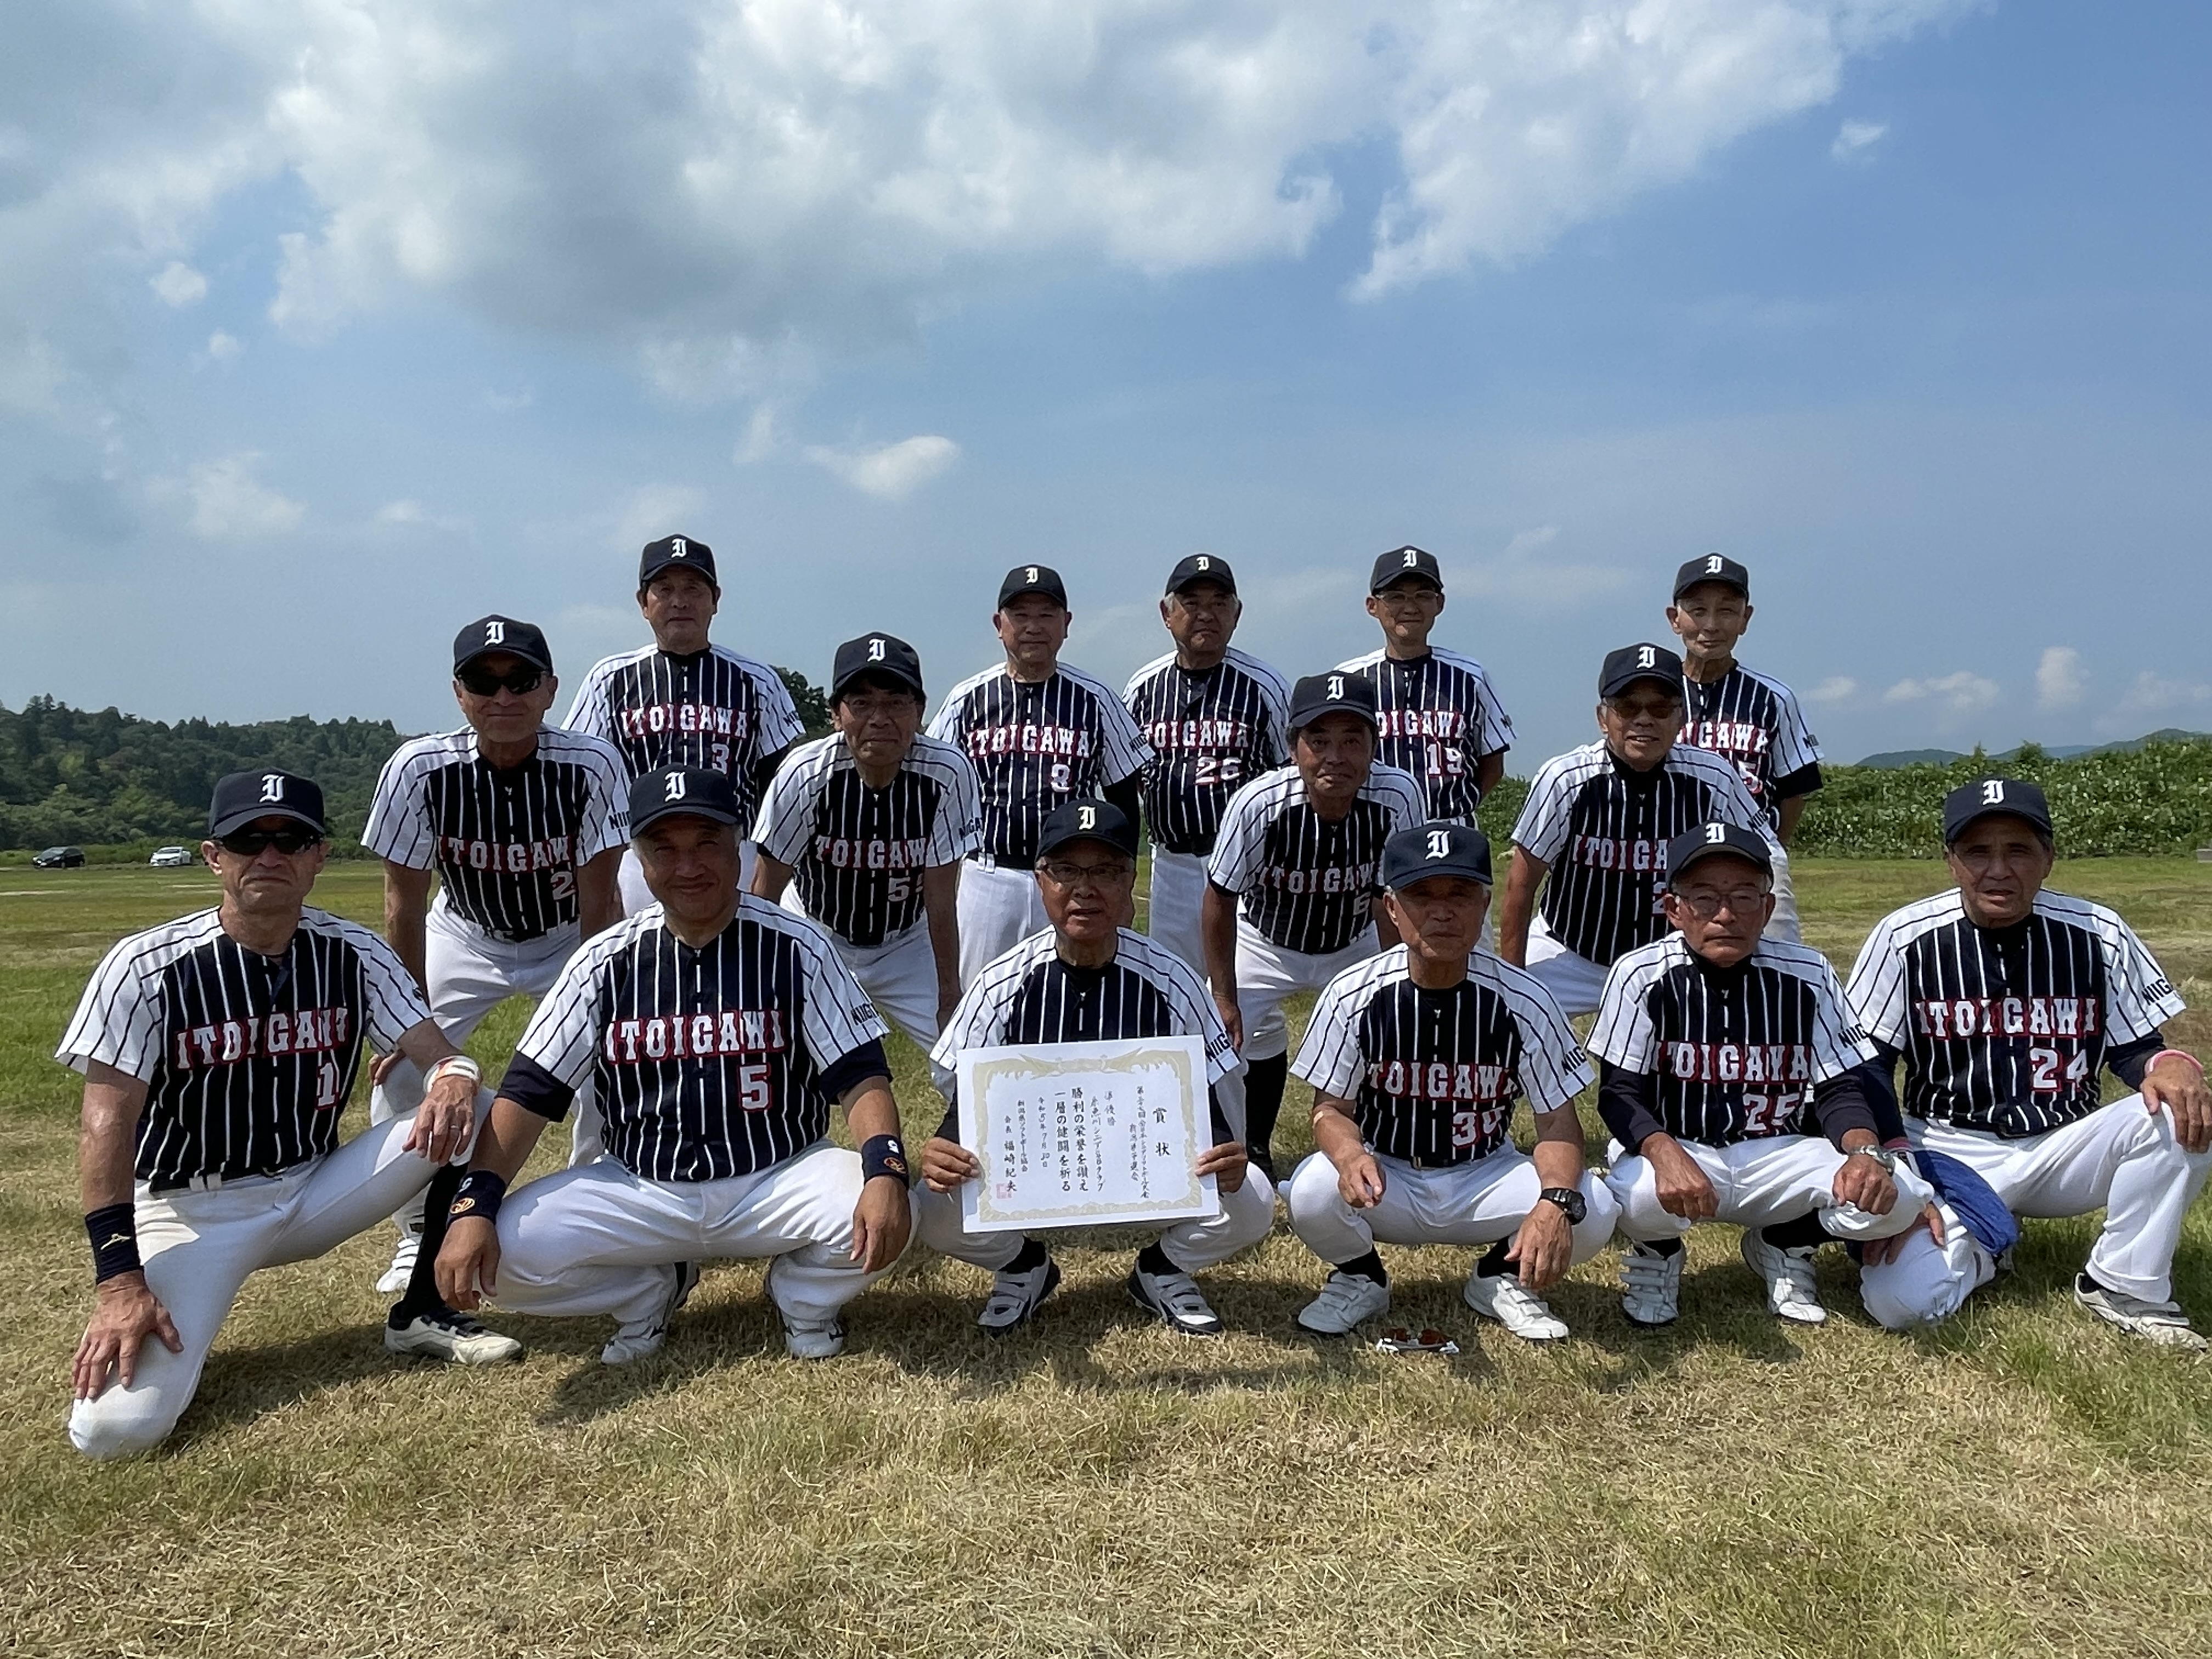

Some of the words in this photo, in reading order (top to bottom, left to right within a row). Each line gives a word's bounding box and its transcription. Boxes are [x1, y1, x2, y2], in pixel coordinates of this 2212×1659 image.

[1427, 744, 1462, 775] 19
[550, 871, 576, 901] 2
[318, 1062, 336, 1107] 1
[740, 1064, 769, 1109] 5
[2032, 1048, 2089, 1089] 24
[1152, 1107, 1171, 1157] 賞状
[1743, 1093, 1802, 1131] 25
